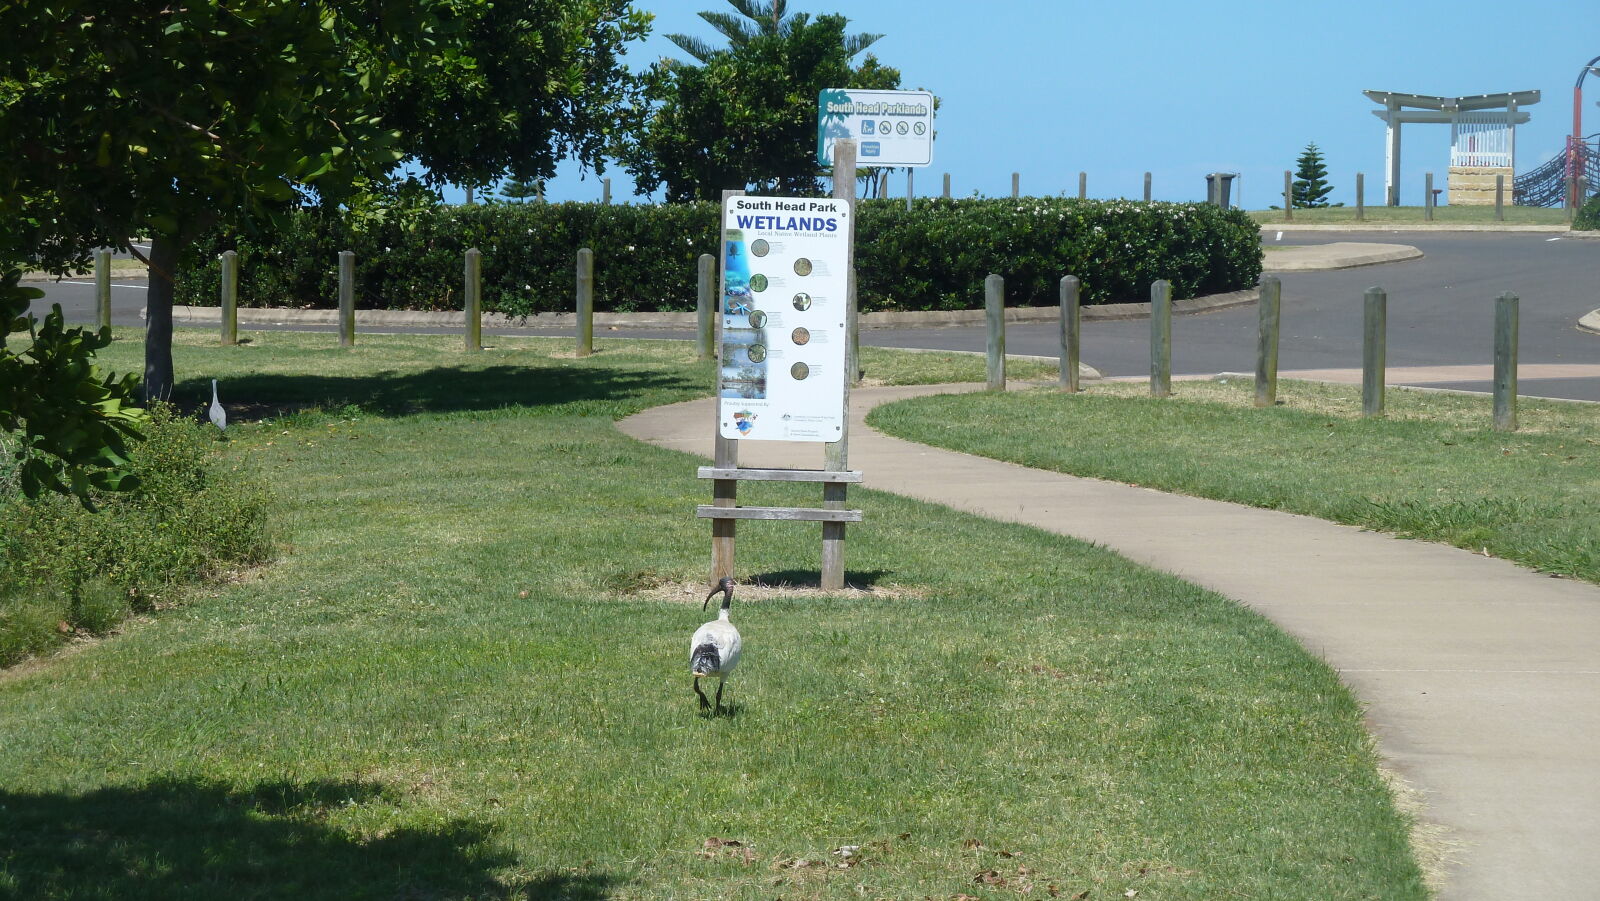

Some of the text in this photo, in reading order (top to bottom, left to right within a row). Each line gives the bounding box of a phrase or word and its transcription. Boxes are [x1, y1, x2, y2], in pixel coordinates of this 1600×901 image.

[827, 102, 927, 116] South Head Parklands
[737, 200, 837, 212] South Head Park
[737, 215, 838, 232] WETLANDS
